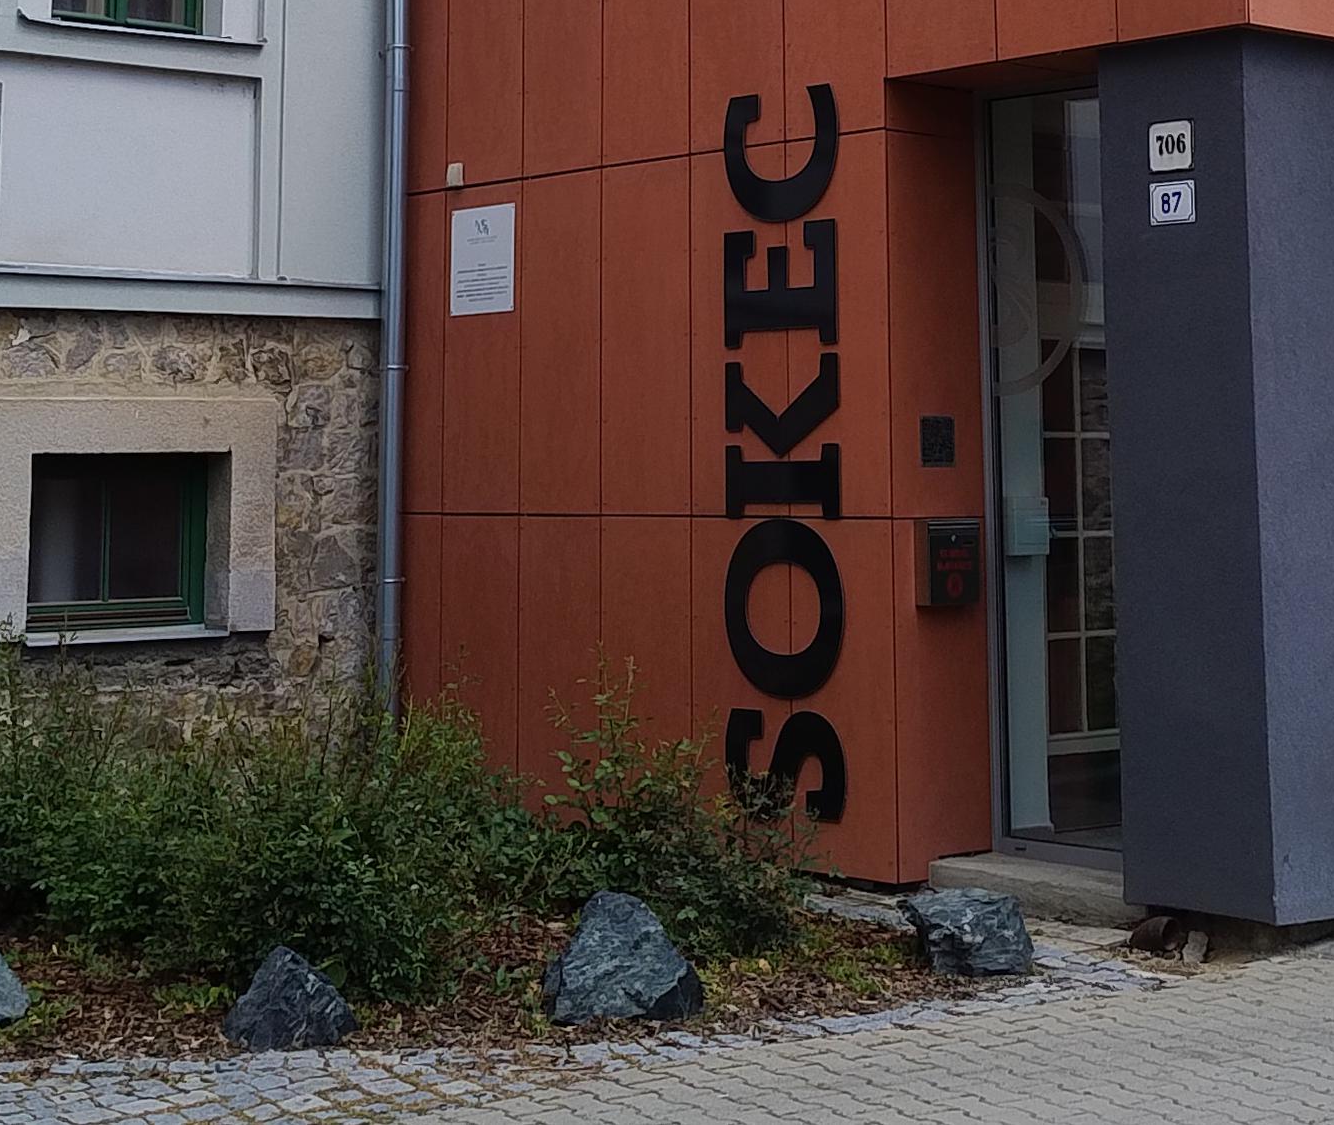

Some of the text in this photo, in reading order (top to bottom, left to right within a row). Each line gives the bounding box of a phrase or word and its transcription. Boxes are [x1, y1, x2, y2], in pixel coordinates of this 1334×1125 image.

[1155, 133, 1187, 156] 706
[1160, 191, 1183, 214] 87
[724, 83, 848, 823] SOKEC
